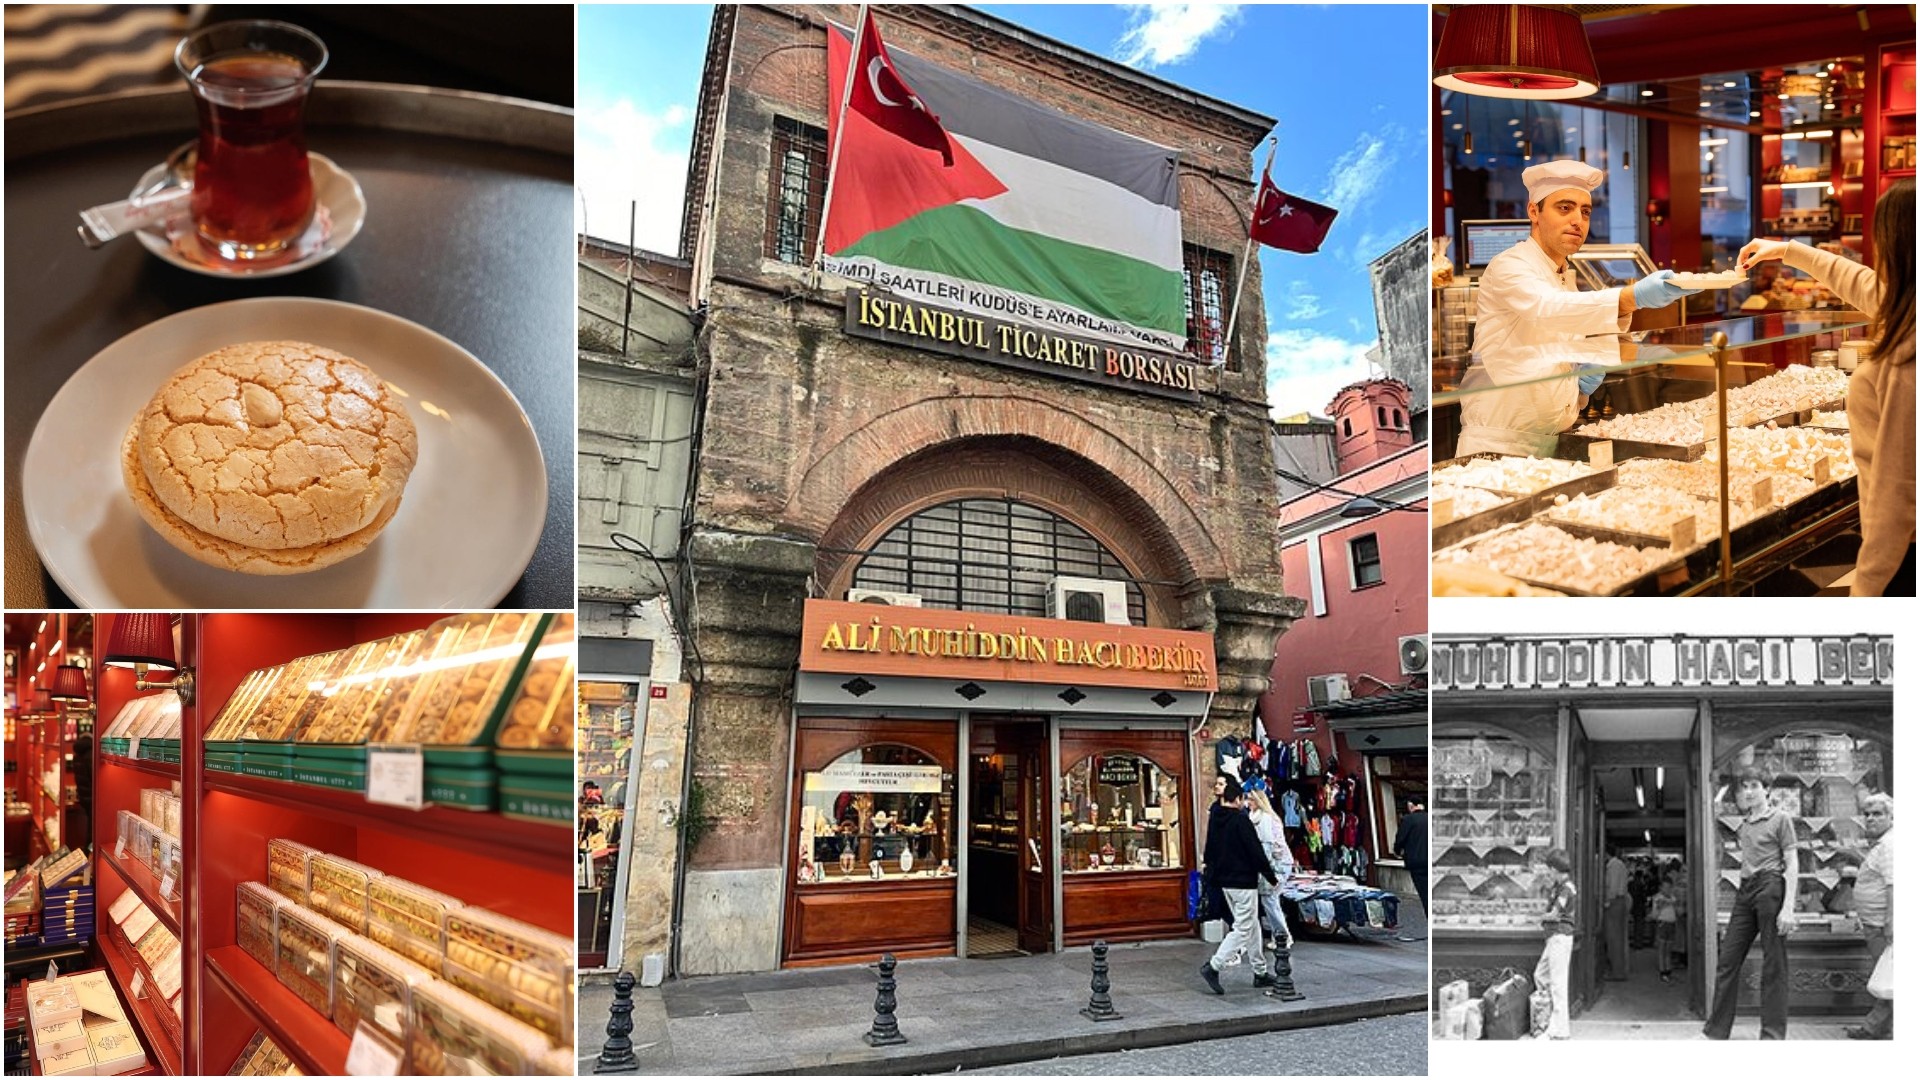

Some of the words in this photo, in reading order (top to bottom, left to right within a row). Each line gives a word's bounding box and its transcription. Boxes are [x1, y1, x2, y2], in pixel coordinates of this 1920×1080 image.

[880, 271, 965, 302] SAATLERİ
[969, 289, 1043, 318] KUDÜS'E
[858, 288, 990, 349] İSTANBUL
[997, 323, 1099, 371] TİCARET
[1105, 346, 1196, 391] BORSASI
[821, 615, 882, 653] ALİ
[889, 622, 1048, 663] MUHİDDİN
[1053, 636, 1122, 669] HACI
[1127, 640, 1208, 673] BEKİR
[1680, 642, 1781, 680] HACI
